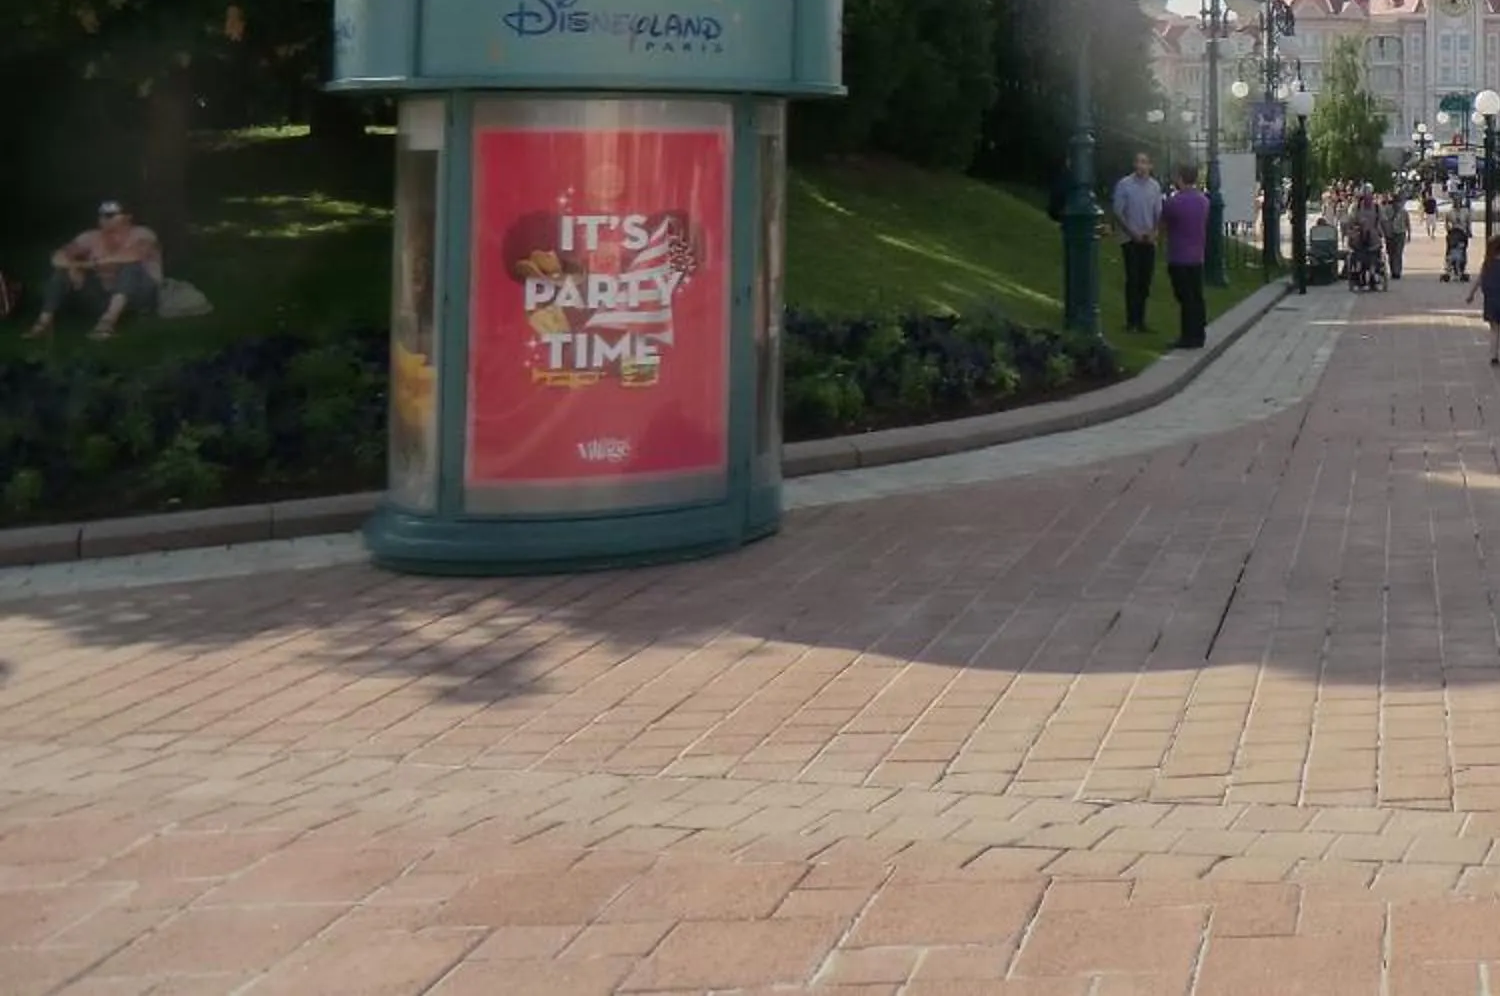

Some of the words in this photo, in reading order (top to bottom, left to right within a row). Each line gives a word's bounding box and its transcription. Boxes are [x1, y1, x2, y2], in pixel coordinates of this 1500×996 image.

[645, 41, 723, 53] PARIS
[561, 214, 649, 251] IT'S
[525, 271, 683, 311] PARTY
[540, 332, 661, 370] TIME
